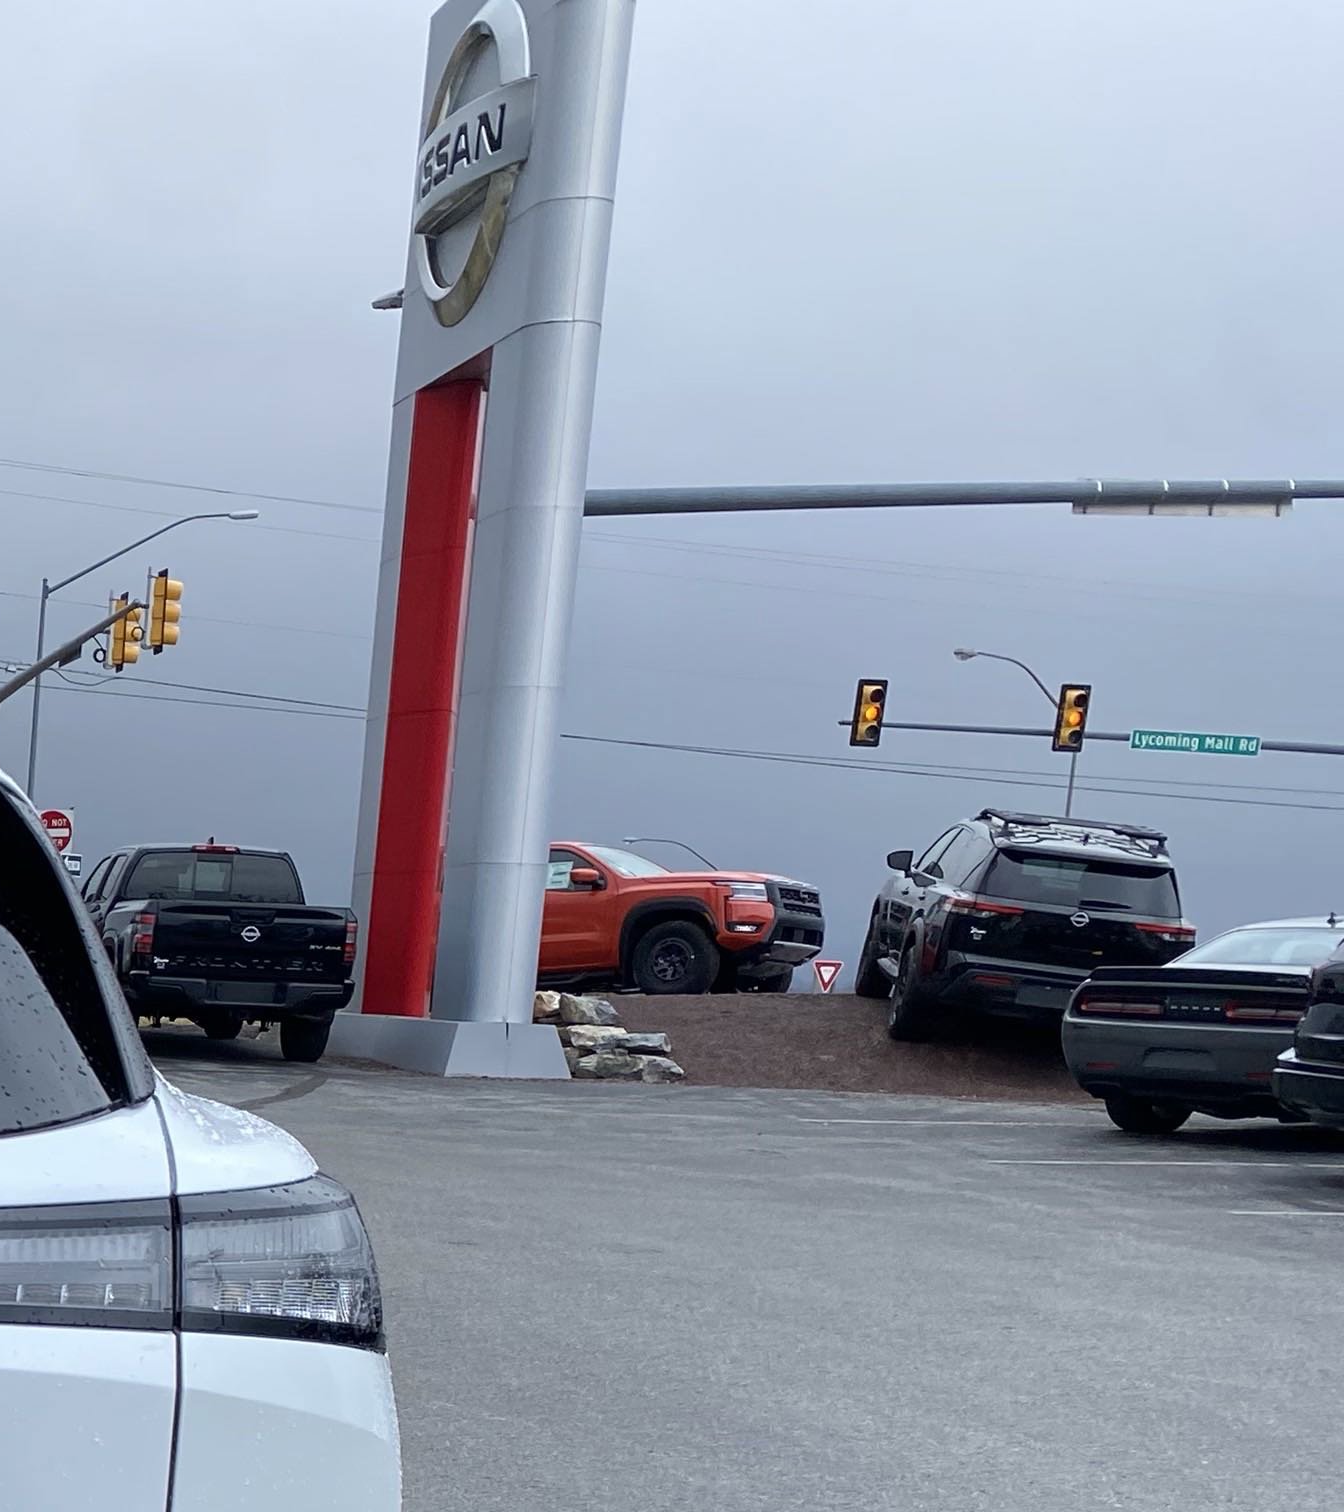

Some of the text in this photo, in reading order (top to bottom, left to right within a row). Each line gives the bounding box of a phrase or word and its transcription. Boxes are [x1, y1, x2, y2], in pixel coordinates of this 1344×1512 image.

[419, 102, 507, 199] SSAN
[1134, 732, 1257, 752] Lycoming Mall Rd
[51, 818, 68, 828] NOT
